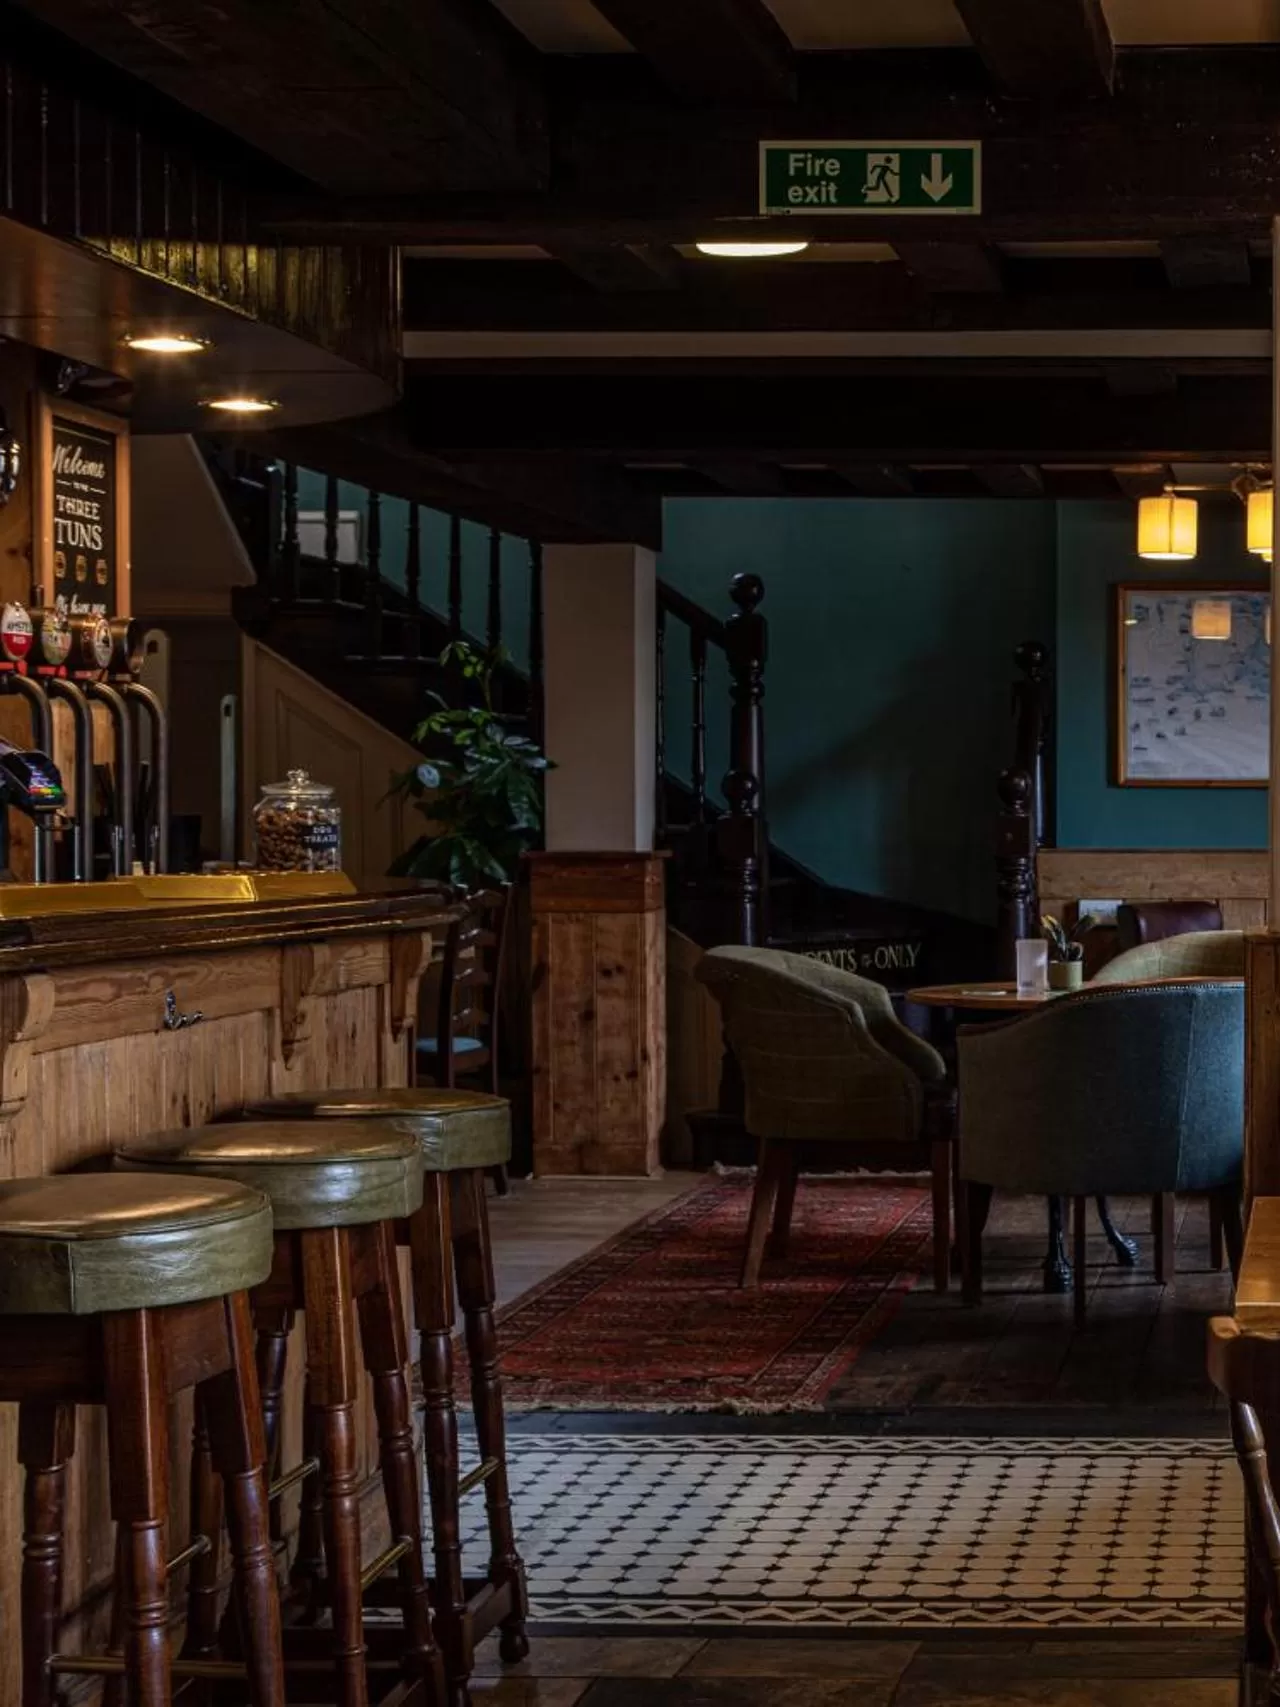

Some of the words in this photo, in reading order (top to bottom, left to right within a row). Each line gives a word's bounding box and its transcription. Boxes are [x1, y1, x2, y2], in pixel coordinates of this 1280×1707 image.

[788, 152, 841, 177] Fire
[787, 181, 838, 204] exit
[53, 443, 107, 480] Welcome
[56, 494, 101, 521] THREE
[54, 517, 103, 551] TUNS
[874, 941, 923, 970] ONLY
